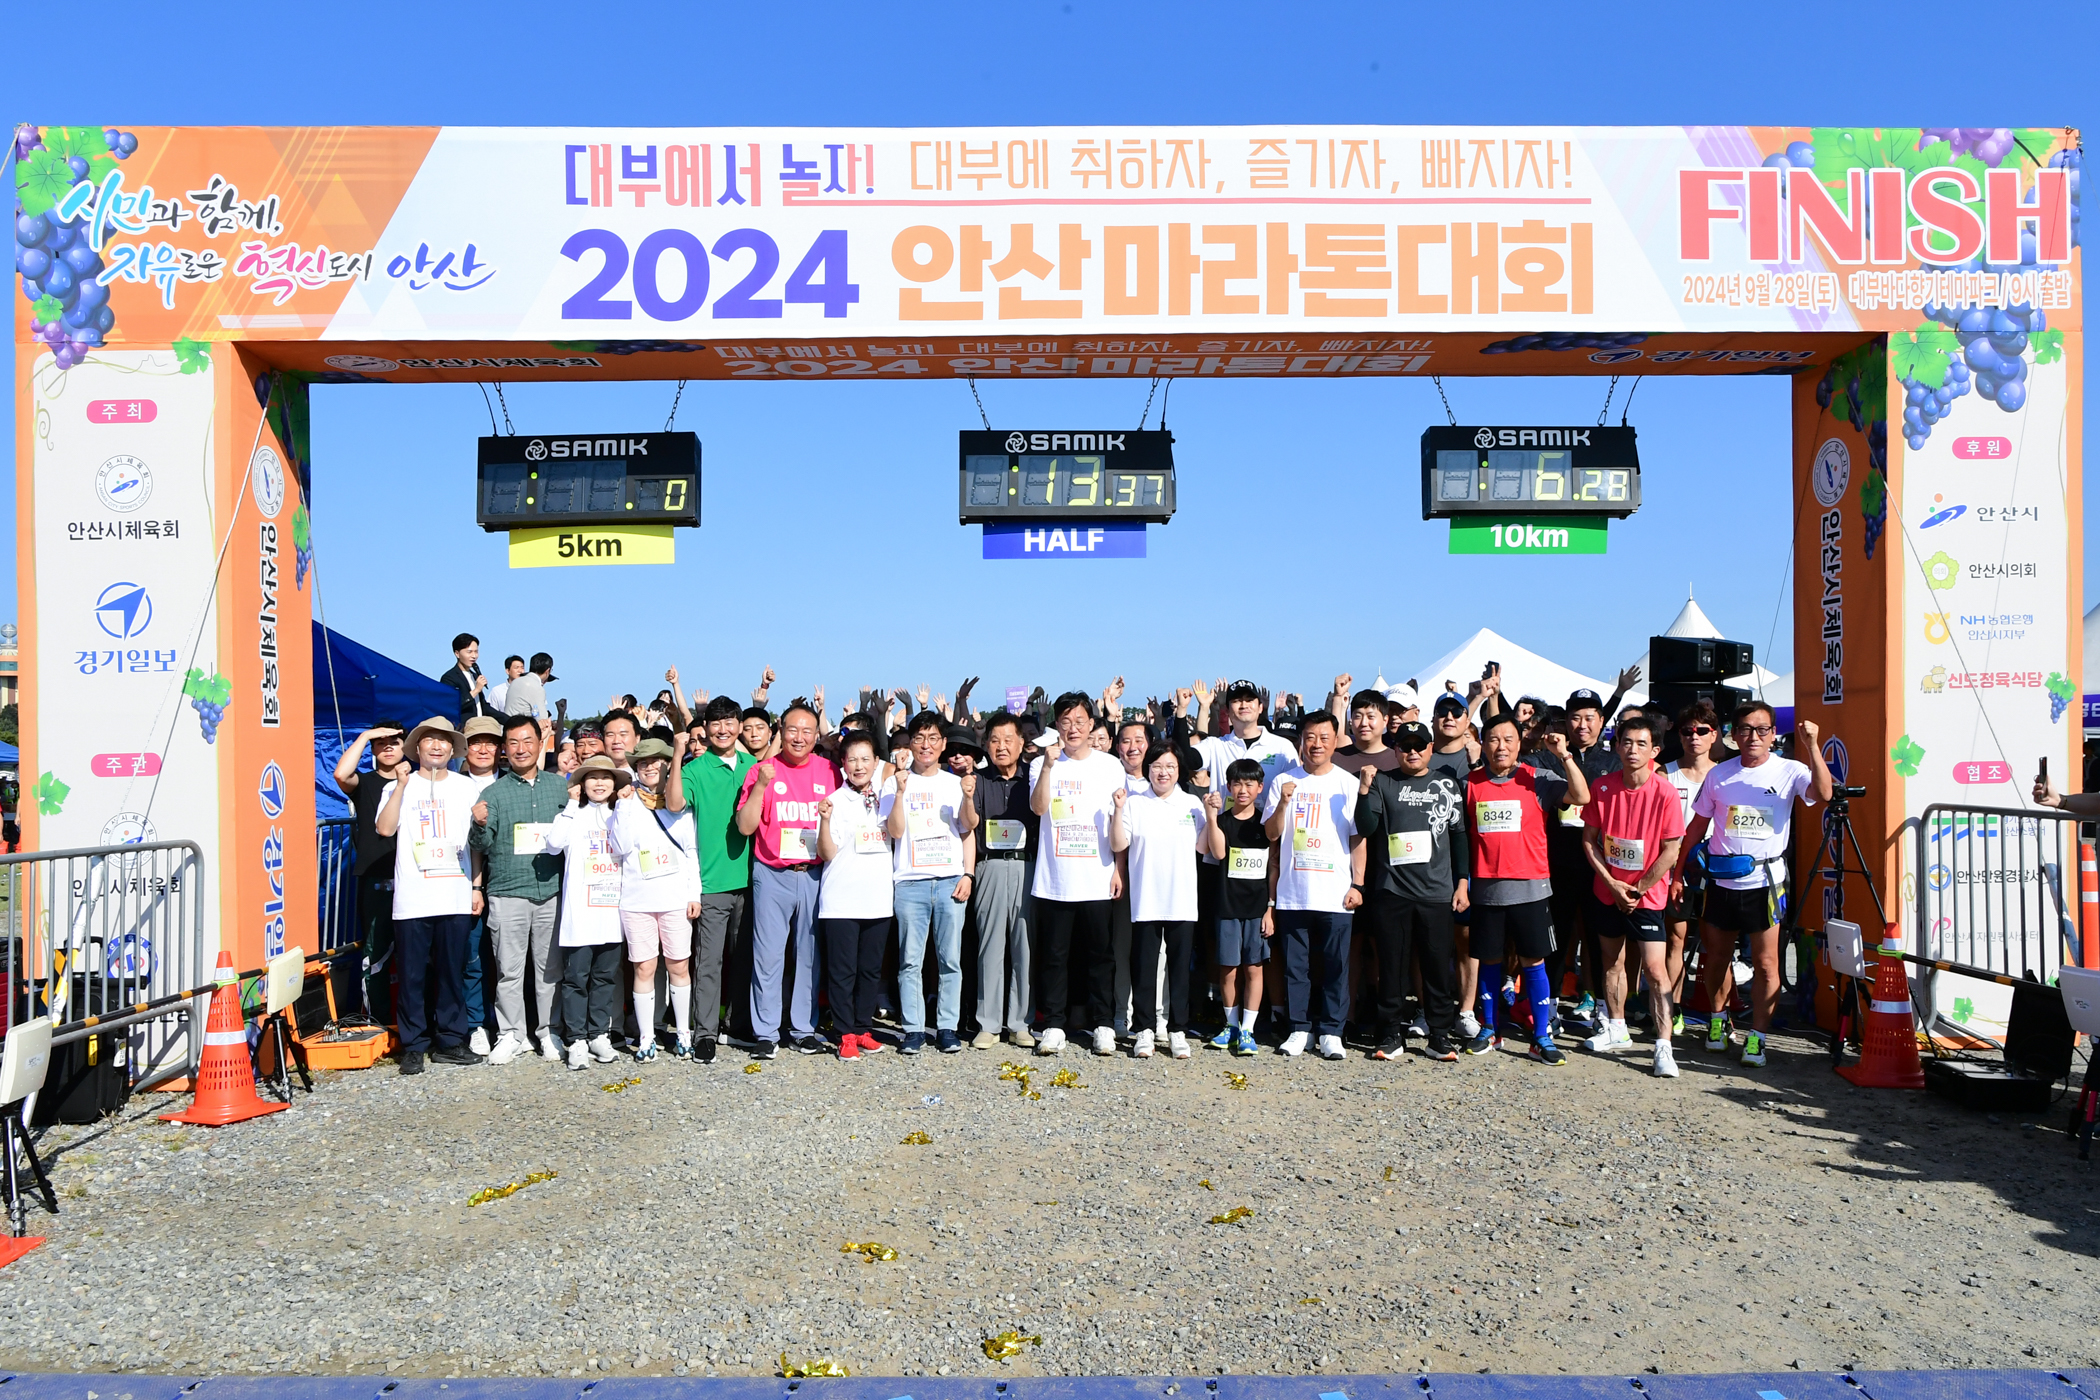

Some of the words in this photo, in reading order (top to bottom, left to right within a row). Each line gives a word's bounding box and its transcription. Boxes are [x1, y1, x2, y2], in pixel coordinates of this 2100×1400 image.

[565, 143, 761, 207] 대부에서
[780, 142, 875, 207] 놀자!
[910, 138, 1049, 190] 대부에
[1070, 138, 1225, 194] 취하자,
[1246, 137, 1400, 194] 즐기자,
[1421, 138, 1572, 190] 빠지자!
[62, 171, 190, 246] 시민과
[191, 177, 283, 234] 함께,
[1678, 168, 2071, 263] FINISH
[100, 245, 223, 308] 자유로운
[238, 244, 373, 302] 혁신도시
[386, 244, 496, 290] 안산
[560, 228, 860, 321] 2024
[891, 219, 1594, 321] 안산마라톤대회
[1683, 274, 1741, 306] 2024년
[1745, 274, 1770, 306] 9월
[1774, 274, 1838, 310] 28일(토)
[1850, 272, 1999, 308] 대부바다향기테마파크
[2040, 272, 2070, 308] 출발
[713, 345, 857, 360] 대부에서
[867, 343, 934, 358] 놀자!
[958, 341, 1058, 355] 대부에
[1072, 340, 1180, 354] 취하자,
[1197, 340, 1304, 354] 즐기자,
[1318, 339, 1434, 352] 빠지자!
[400, 357, 603, 368] 안산시체육회
[731, 358, 928, 377] 2024
[948, 354, 1432, 376] 안산마라톤대회
[1030, 433, 1126, 451] SAMIK
[1499, 429, 1591, 447] SAMIK
[550, 438, 648, 458] SAMIK
[67, 519, 180, 541] 안산시체육회
[1489, 524, 1569, 550] 10km
[557, 533, 623, 559] 5km
[1023, 527, 1105, 553] HALF
[1968, 562, 2037, 580] 안산시의회
[1820, 510, 1843, 702] 안산시체육회
[259, 523, 279, 727] 안산시체육회
[1960, 615, 1986, 625] NH
[1988, 614, 2034, 625] 농협은행
[1967, 629, 2026, 641] 안산시지부
[73, 648, 177, 675] 경기일보
[1947, 671, 2043, 689] 신도정육식당
[776, 800, 820, 822] KORE
[1069, 804, 1075, 815] 1
[1483, 810, 1513, 821] 8342
[1732, 814, 1765, 827] 8270
[533, 833, 540, 843] 7
[862, 831, 888, 842] 9182
[1001, 829, 1009, 839] 4
[1306, 837, 1321, 849] 50
[430, 847, 445, 858] 13
[1405, 842, 1413, 853] 5
[1609, 845, 1635, 860] 8818
[592, 862, 619, 874] 9043
[655, 853, 669, 865] 12
[1235, 857, 1263, 868] 8780
